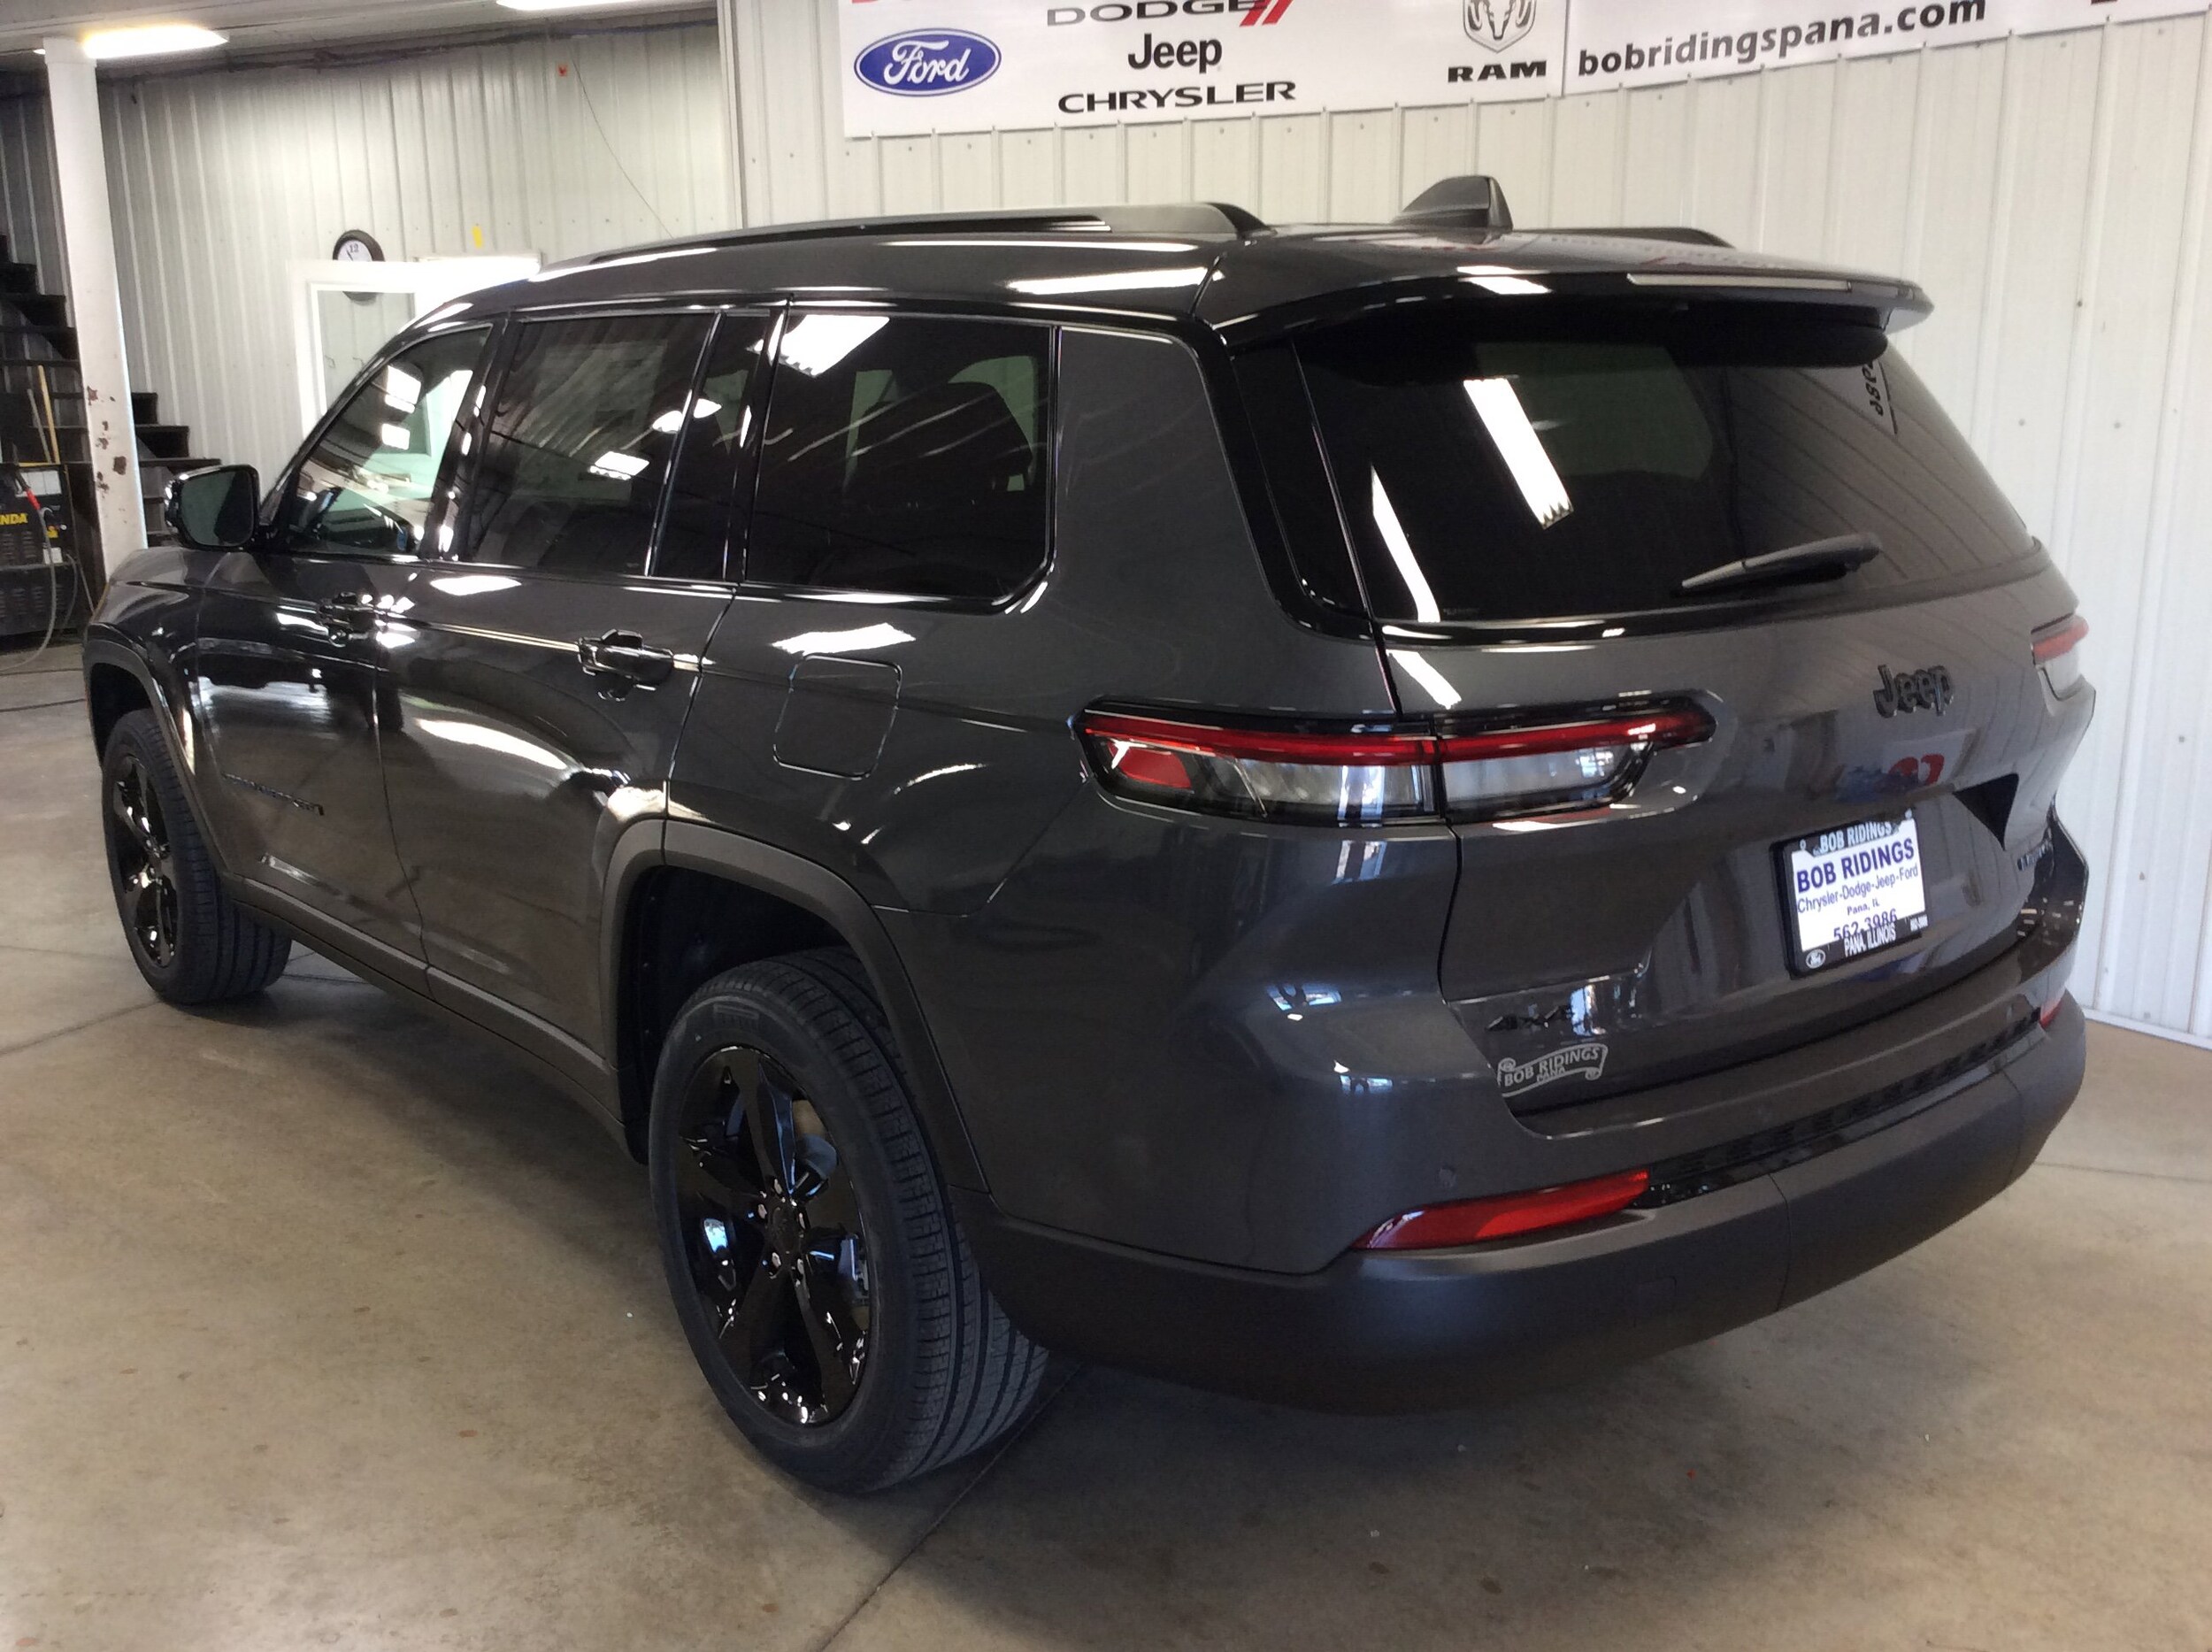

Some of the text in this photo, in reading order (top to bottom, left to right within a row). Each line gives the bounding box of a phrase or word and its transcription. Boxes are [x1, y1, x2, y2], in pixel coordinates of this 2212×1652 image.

[1047, 0, 1267, 26] DODGE
[1127, 33, 1223, 74] Jeep
[1578, 0, 1985, 76] bobridingspana.com
[883, 39, 972, 85] Ford
[1448, 60, 1548, 83] RAM
[1057, 81, 1296, 113] CHRYSLER
[349, 243, 359, 253] 12
[1873, 665, 1953, 718] Jeep
[1819, 820, 1893, 853] BOB RIDINGS
[1796, 838, 1915, 893] BOB RIDINGS
[1504, 1047, 1601, 1087] BOB RIDINGS
